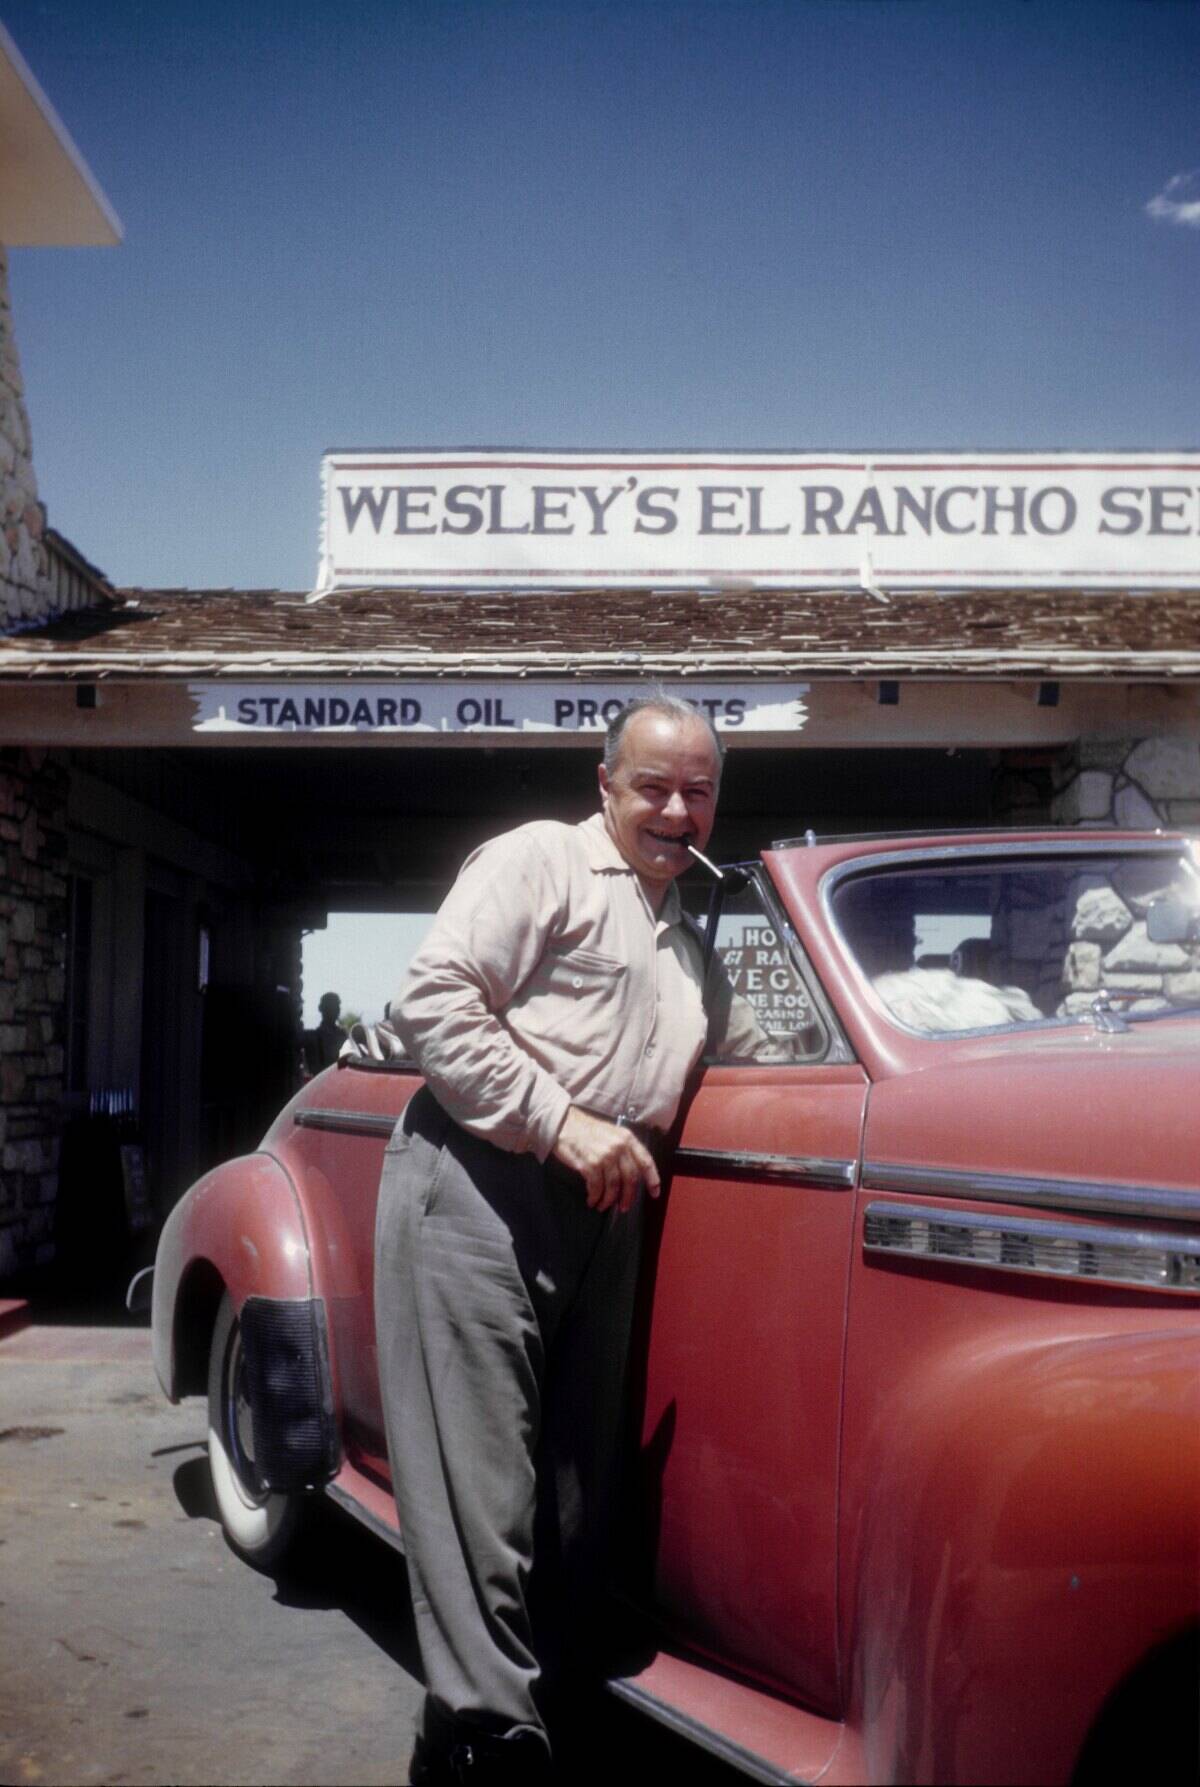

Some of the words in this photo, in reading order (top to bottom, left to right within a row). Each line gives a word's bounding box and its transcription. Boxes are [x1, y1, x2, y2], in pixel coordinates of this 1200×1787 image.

[338, 477, 679, 536] WESLEY'S
[698, 486, 790, 536] EL
[802, 486, 1077, 536] RANCHO
[1098, 486, 1200, 536] SE
[237, 698, 421, 726] STANDARD
[457, 698, 514, 727] OIL
[555, 698, 746, 727] PROTS
[746, 928, 777, 946] HO
[756, 950, 787, 965] RA
[727, 969, 800, 990] VEG
[747, 993, 768, 1008] NE
